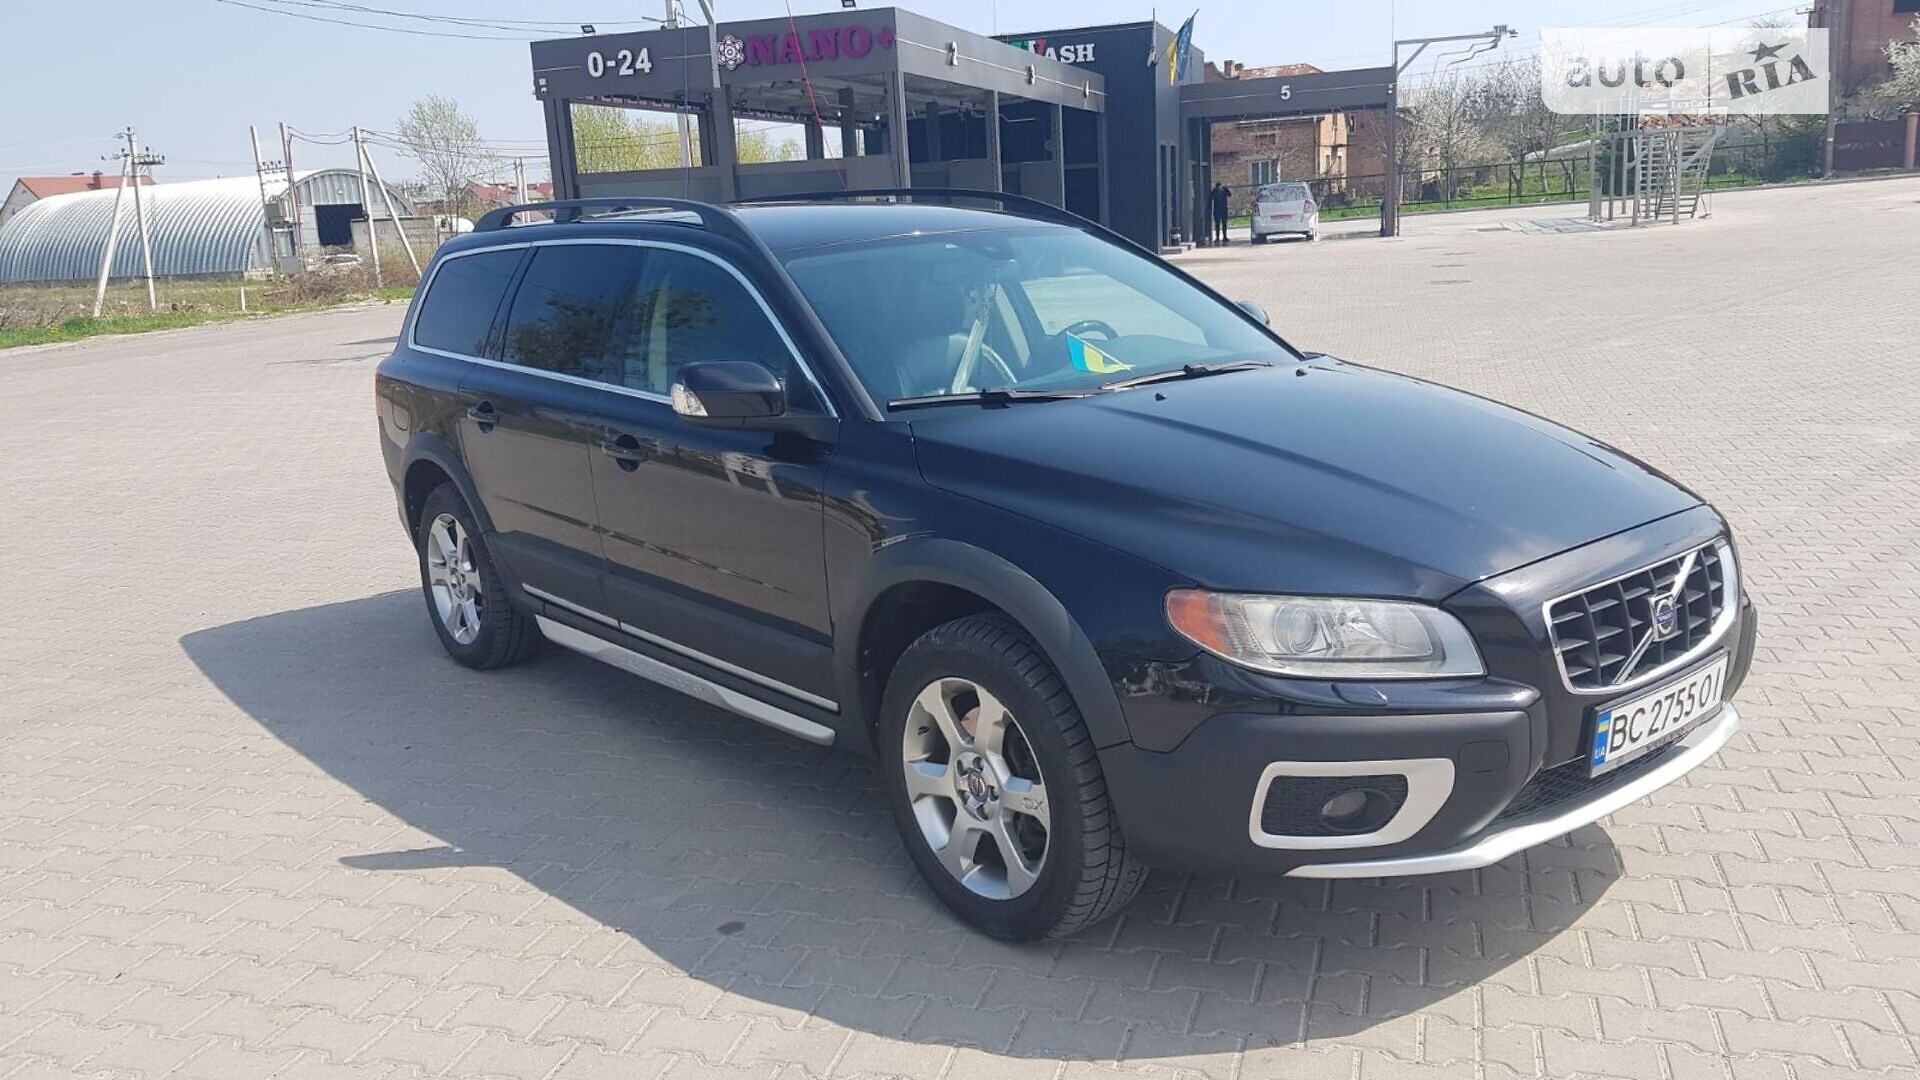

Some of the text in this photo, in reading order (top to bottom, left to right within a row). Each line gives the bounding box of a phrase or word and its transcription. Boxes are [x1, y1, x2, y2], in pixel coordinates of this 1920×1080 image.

[587, 47, 652, 78] 0-24
[1280, 85, 1291, 100] 5
[1609, 708, 1646, 753] BC
[1647, 682, 1697, 737] 2755
